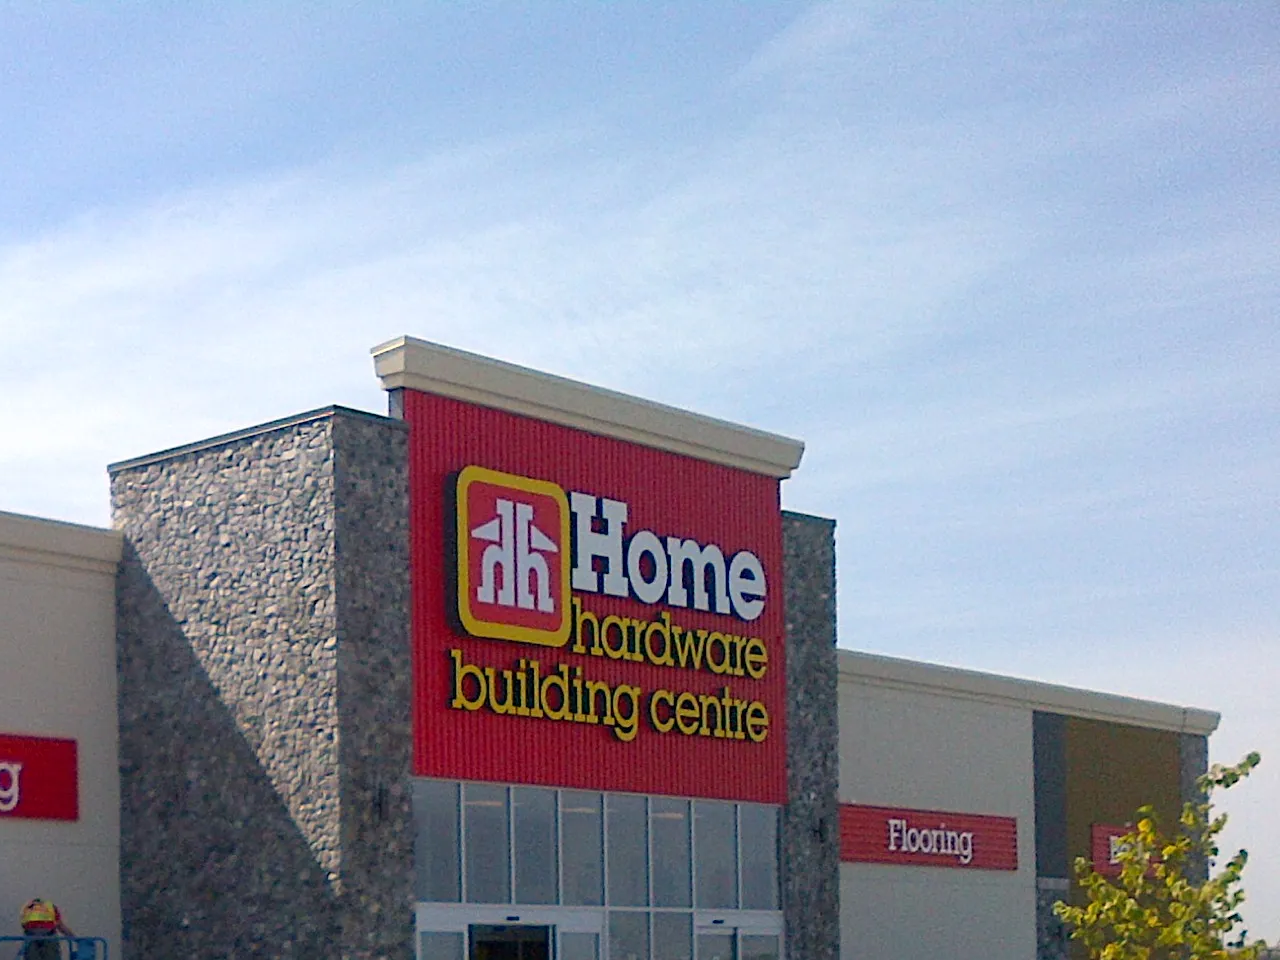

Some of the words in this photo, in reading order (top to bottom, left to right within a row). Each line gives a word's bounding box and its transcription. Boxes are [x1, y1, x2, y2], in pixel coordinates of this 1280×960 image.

[570, 491, 767, 621] Home
[571, 596, 769, 680] hardware
[450, 648, 642, 742] building
[650, 686, 769, 742] centre
[887, 818, 973, 864] Flooring
